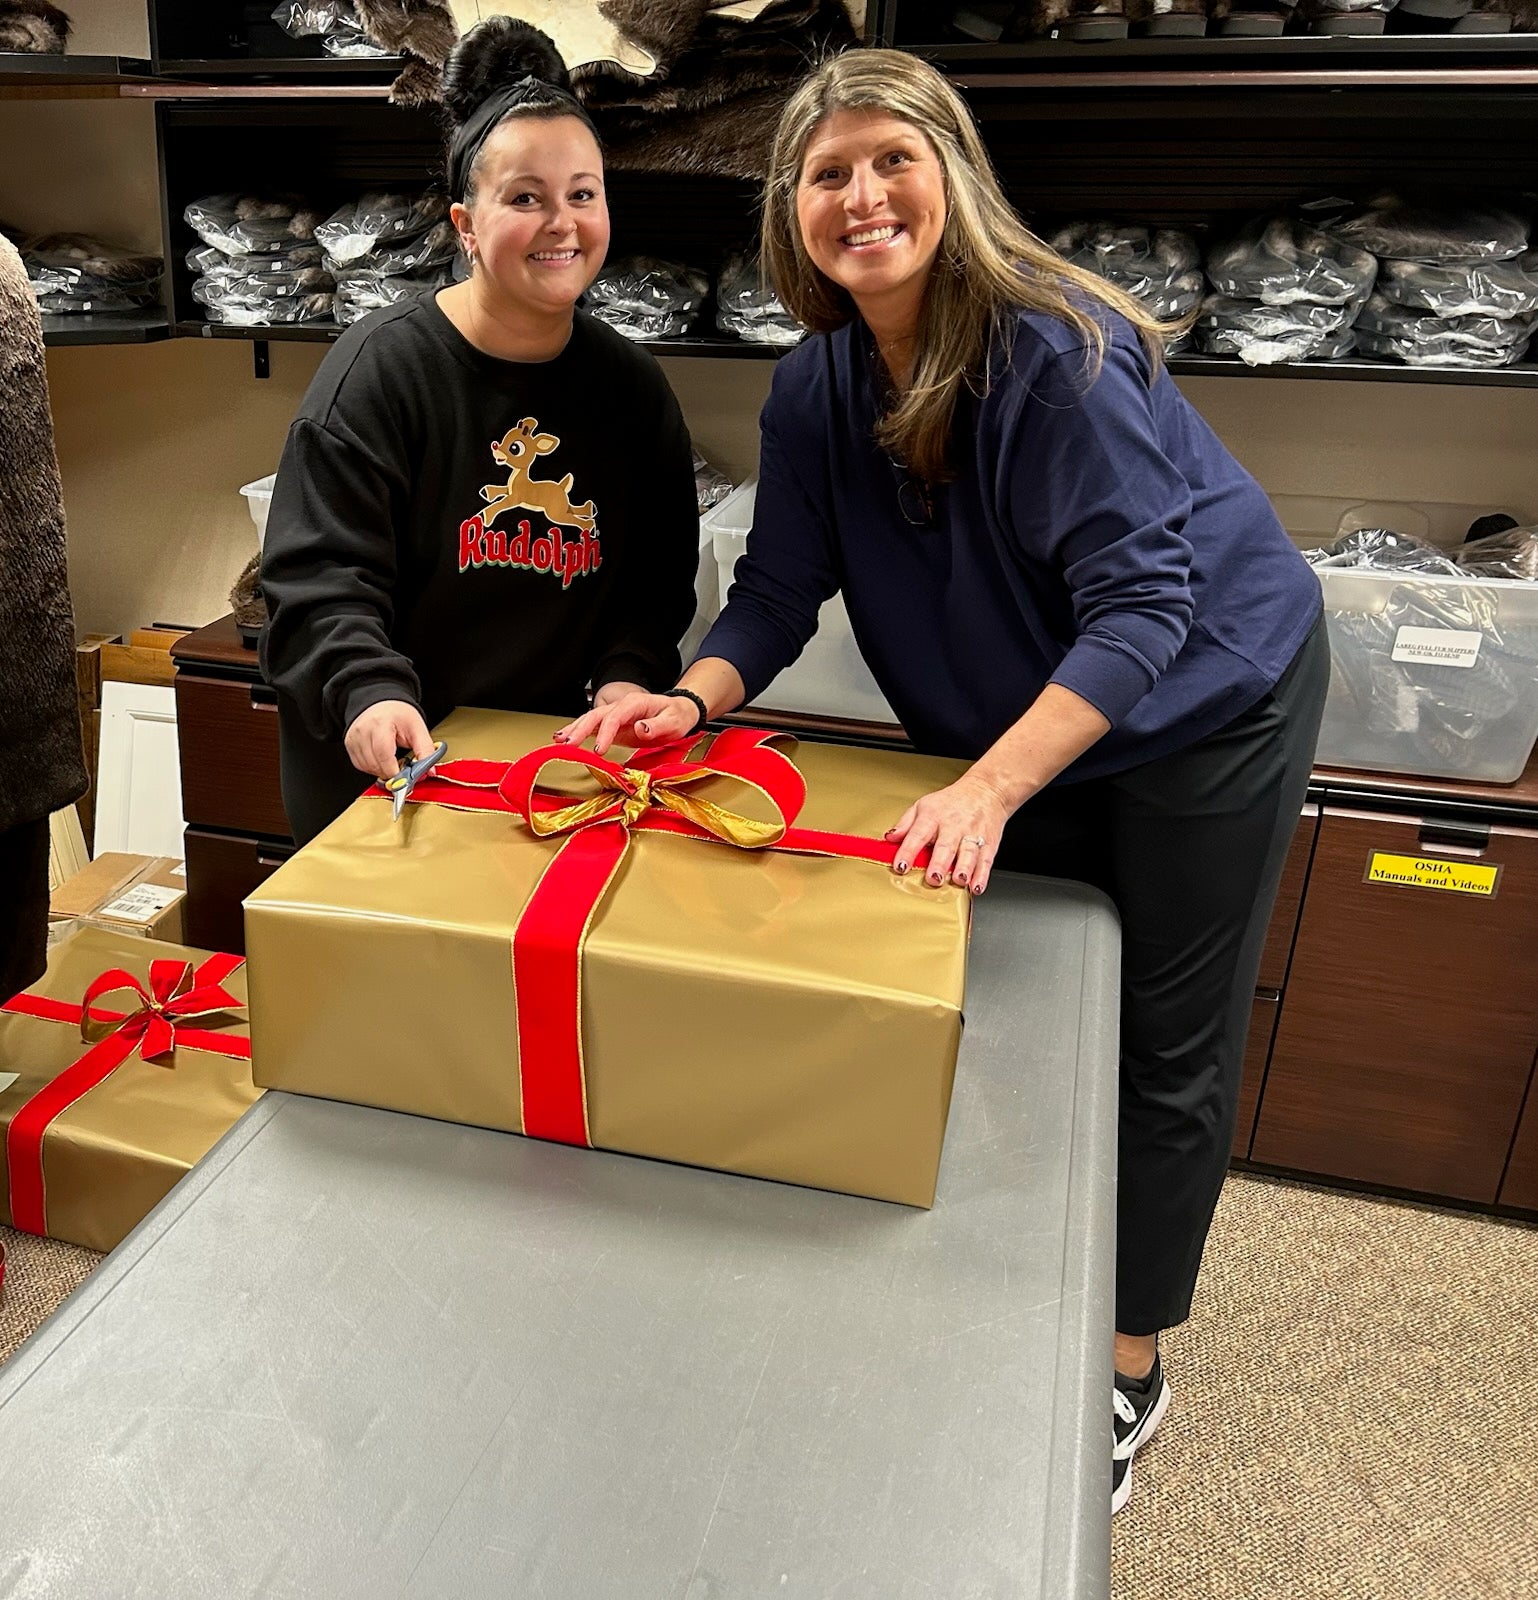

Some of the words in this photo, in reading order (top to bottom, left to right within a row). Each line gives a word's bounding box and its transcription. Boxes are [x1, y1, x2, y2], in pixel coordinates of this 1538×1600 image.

[459, 515, 602, 590] Rudolph
[1415, 862, 1453, 874] OSHA
[1373, 869, 1422, 883] Manuals
[1425, 877, 1447, 886] and
[1451, 879, 1490, 892] Videos
